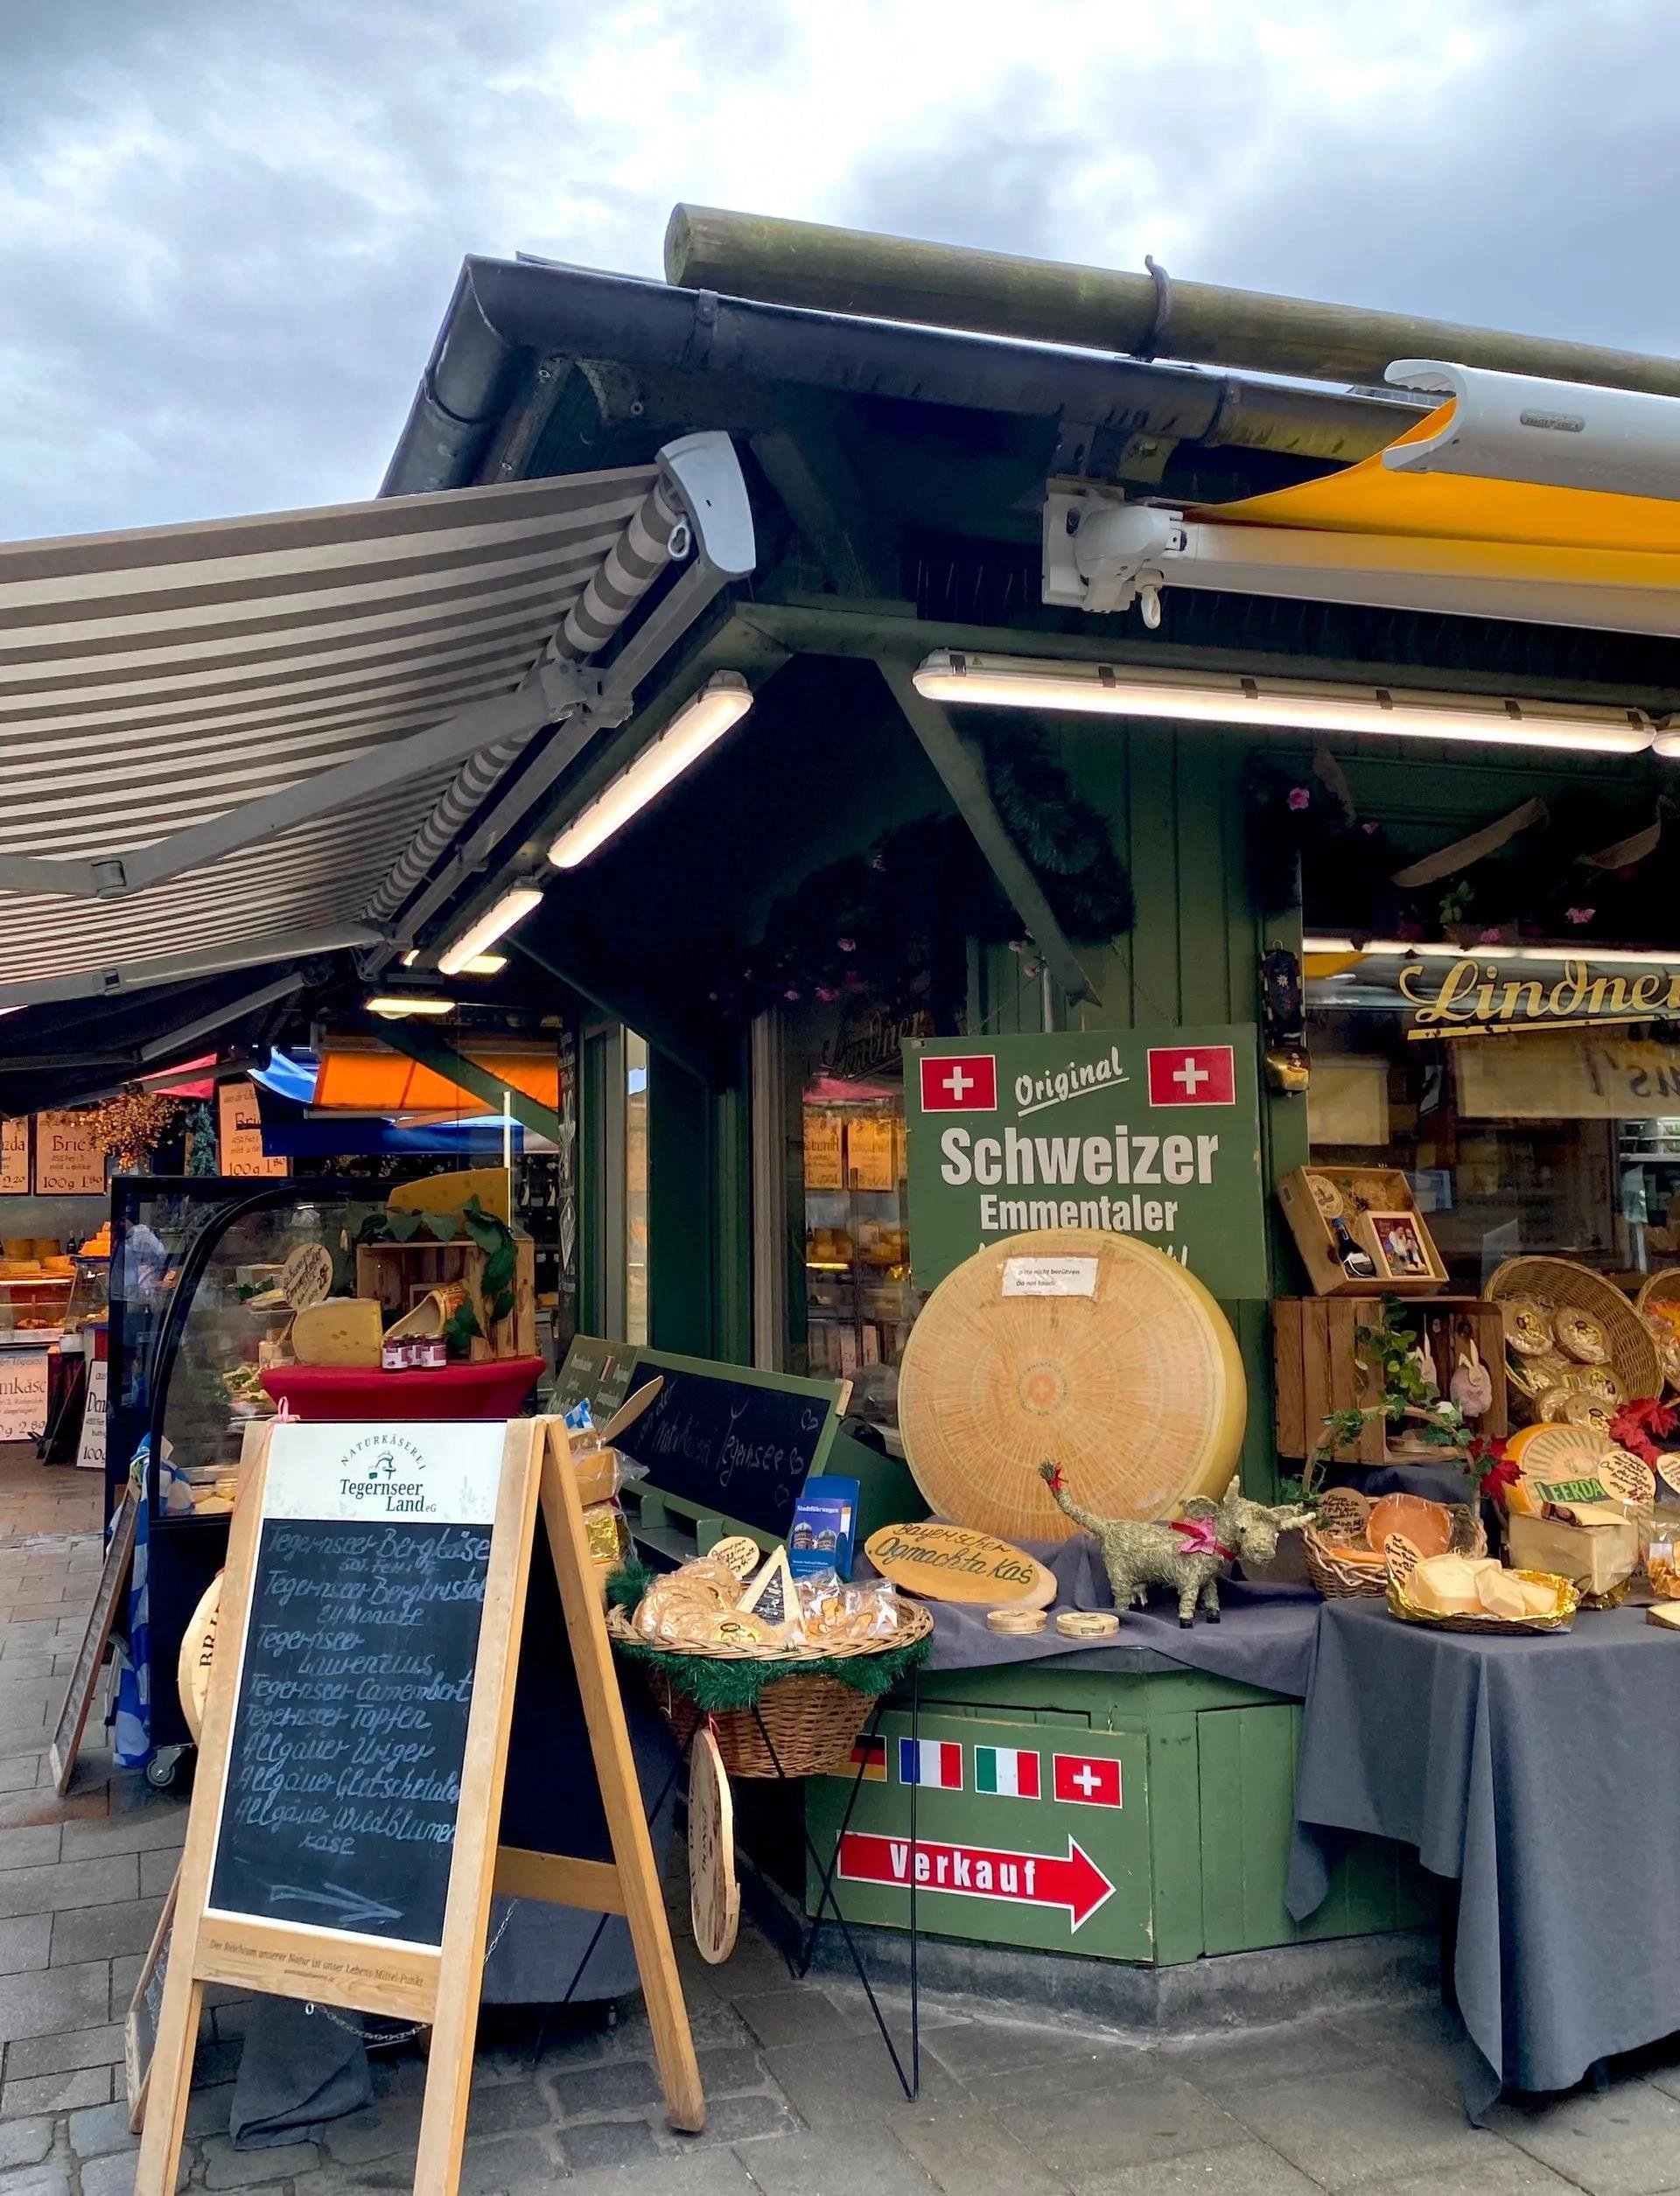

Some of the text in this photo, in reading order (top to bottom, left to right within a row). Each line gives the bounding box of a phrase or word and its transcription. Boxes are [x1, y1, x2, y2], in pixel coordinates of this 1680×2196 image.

[1015, 1046, 1124, 1106] Original
[941, 1125, 1218, 1185] Schweizer
[43, 1176, 75, 1190] 100g
[980, 1194, 1178, 1232] Emmentaler
[341, 1433, 426, 1471] NATURKÄSEREI
[340, 1479, 424, 1500] Tegernseer
[386, 1495, 424, 1512] Land
[1534, 1479, 1607, 1502] LEERDA
[268, 1526, 374, 1561] Tegernseer
[893, 1523, 1011, 1553] Bayerischer
[263, 1570, 372, 1606] Tegernseer
[258, 1625, 365, 1657] Tegernseer
[252, 1669, 473, 1706] Tegernseer Camembert
[242, 1704, 432, 1736] Tegernseer Topfen
[890, 1843, 1036, 1896] Verkauf
[289, 1954, 309, 1966] Natur
